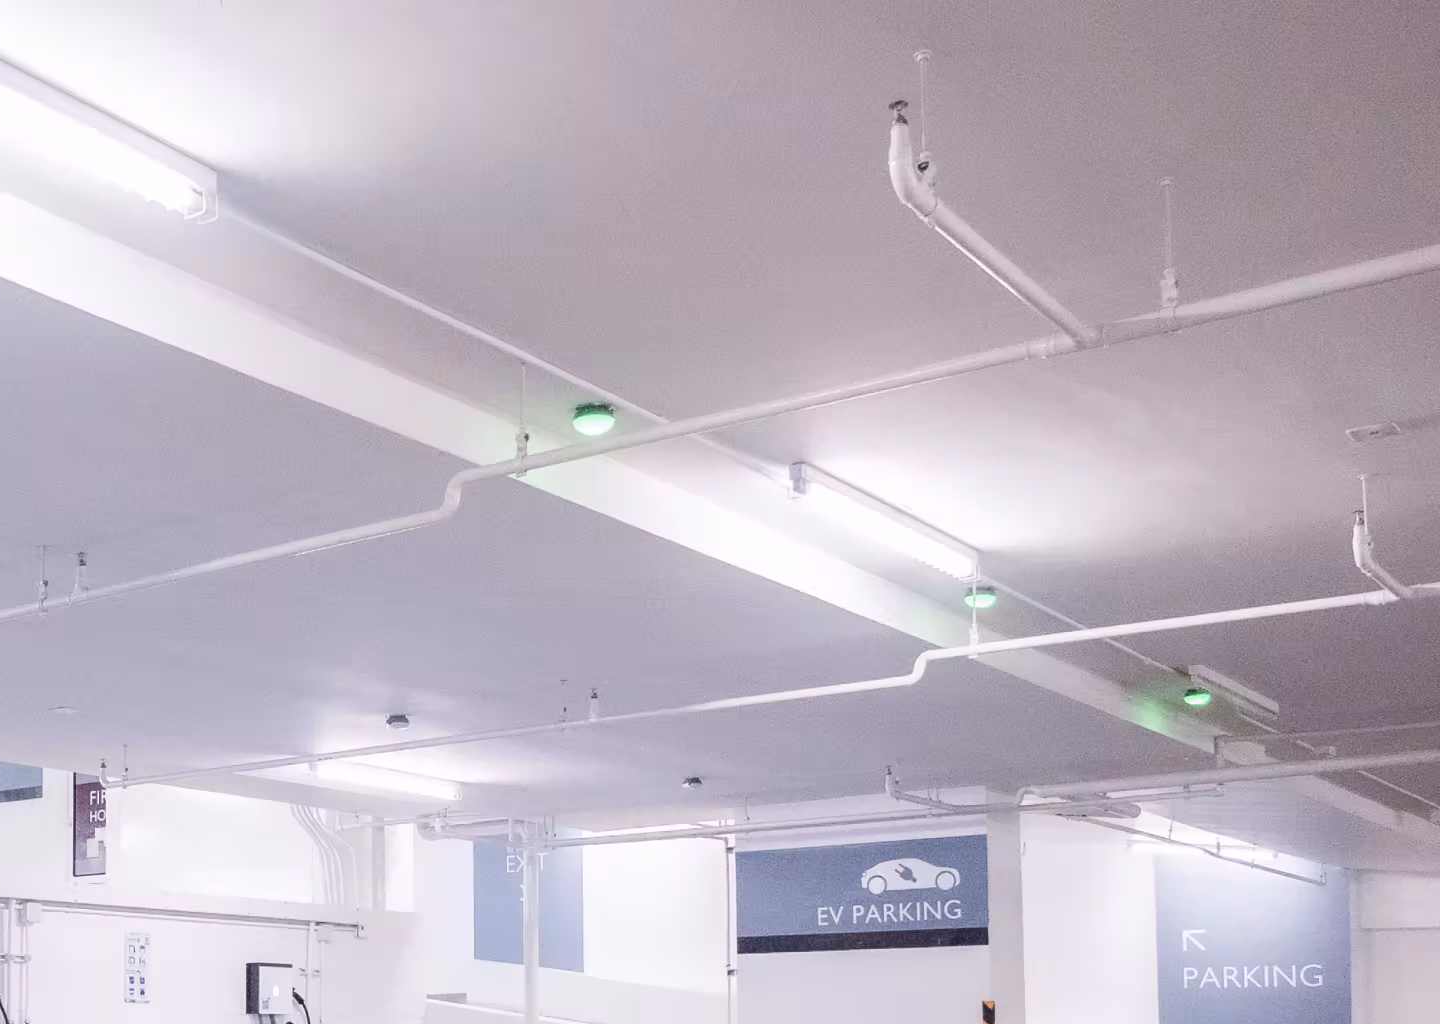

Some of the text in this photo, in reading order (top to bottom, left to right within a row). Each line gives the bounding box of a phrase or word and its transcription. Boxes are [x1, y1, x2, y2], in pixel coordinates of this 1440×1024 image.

[506, 852, 549, 873] EXT
[817, 899, 962, 926] EV PARKING
[1183, 963, 1324, 989] PARKING
